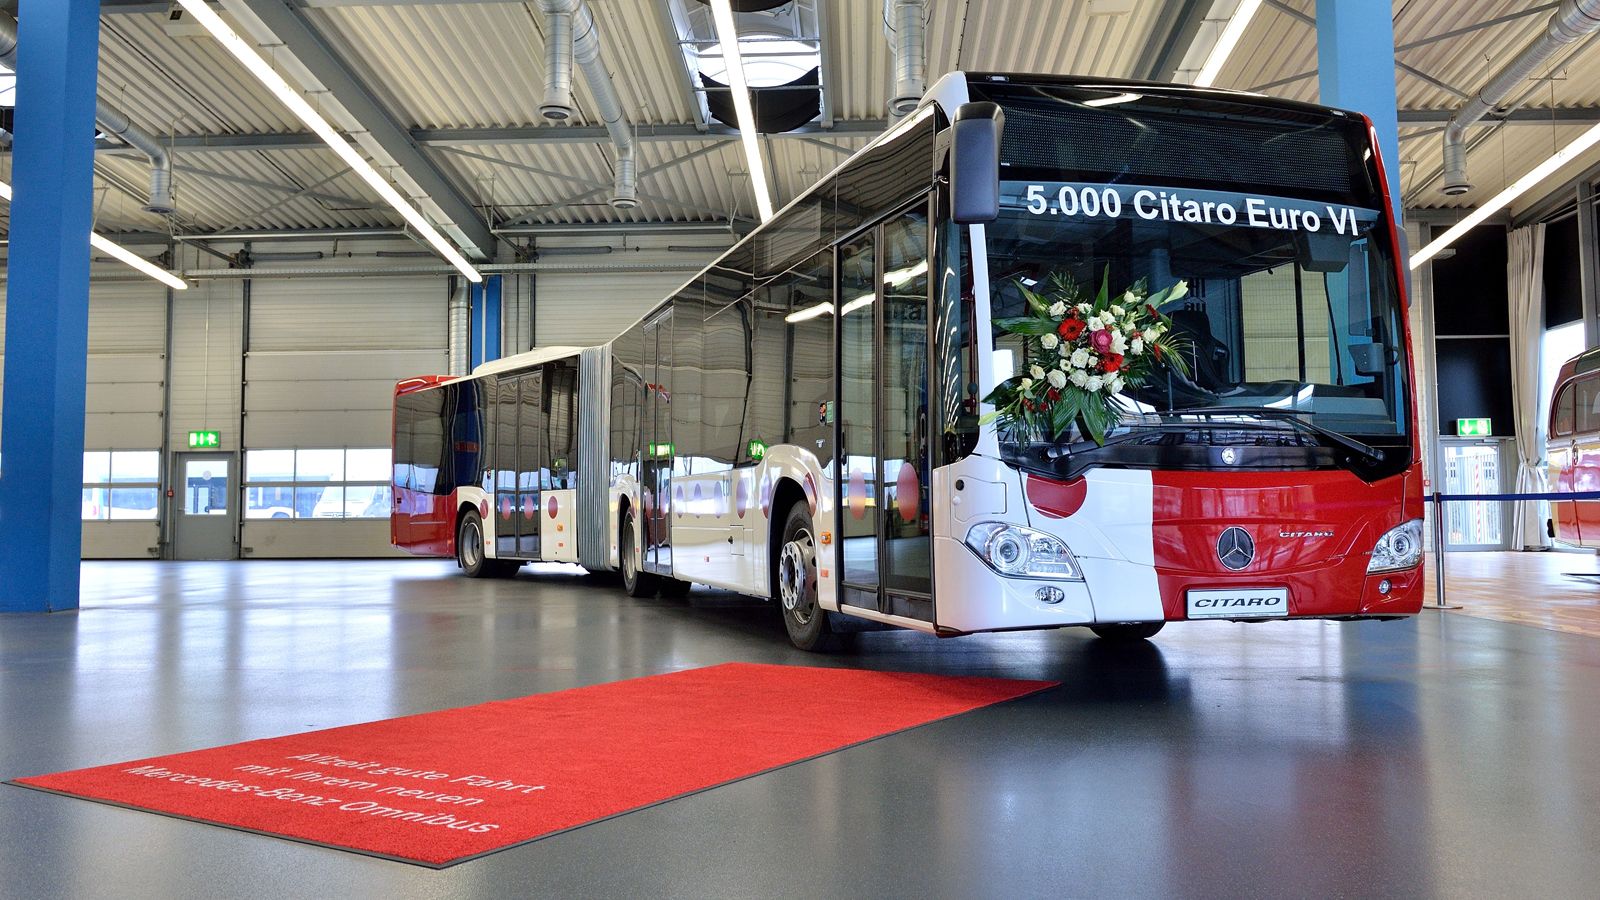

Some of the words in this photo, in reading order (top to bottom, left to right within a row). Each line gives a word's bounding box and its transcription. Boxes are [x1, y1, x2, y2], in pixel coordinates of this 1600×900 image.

[1027, 185, 1122, 218] 5.000
[1134, 190, 1237, 226] Citaro
[1246, 198, 1321, 232] Euro
[1326, 206, 1359, 236] VI
[1195, 597, 1281, 608] CITARO
[234, 764, 293, 776] mit
[285, 771, 378, 790] Ihrem
[376, 786, 485, 806] neuen
[286, 753, 380, 770] Allzeit
[367, 766, 450, 782] gute
[449, 775, 545, 794] Fahrt
[122, 764, 341, 806] Mercedes-Benz
[339, 801, 500, 834] Omnibus
